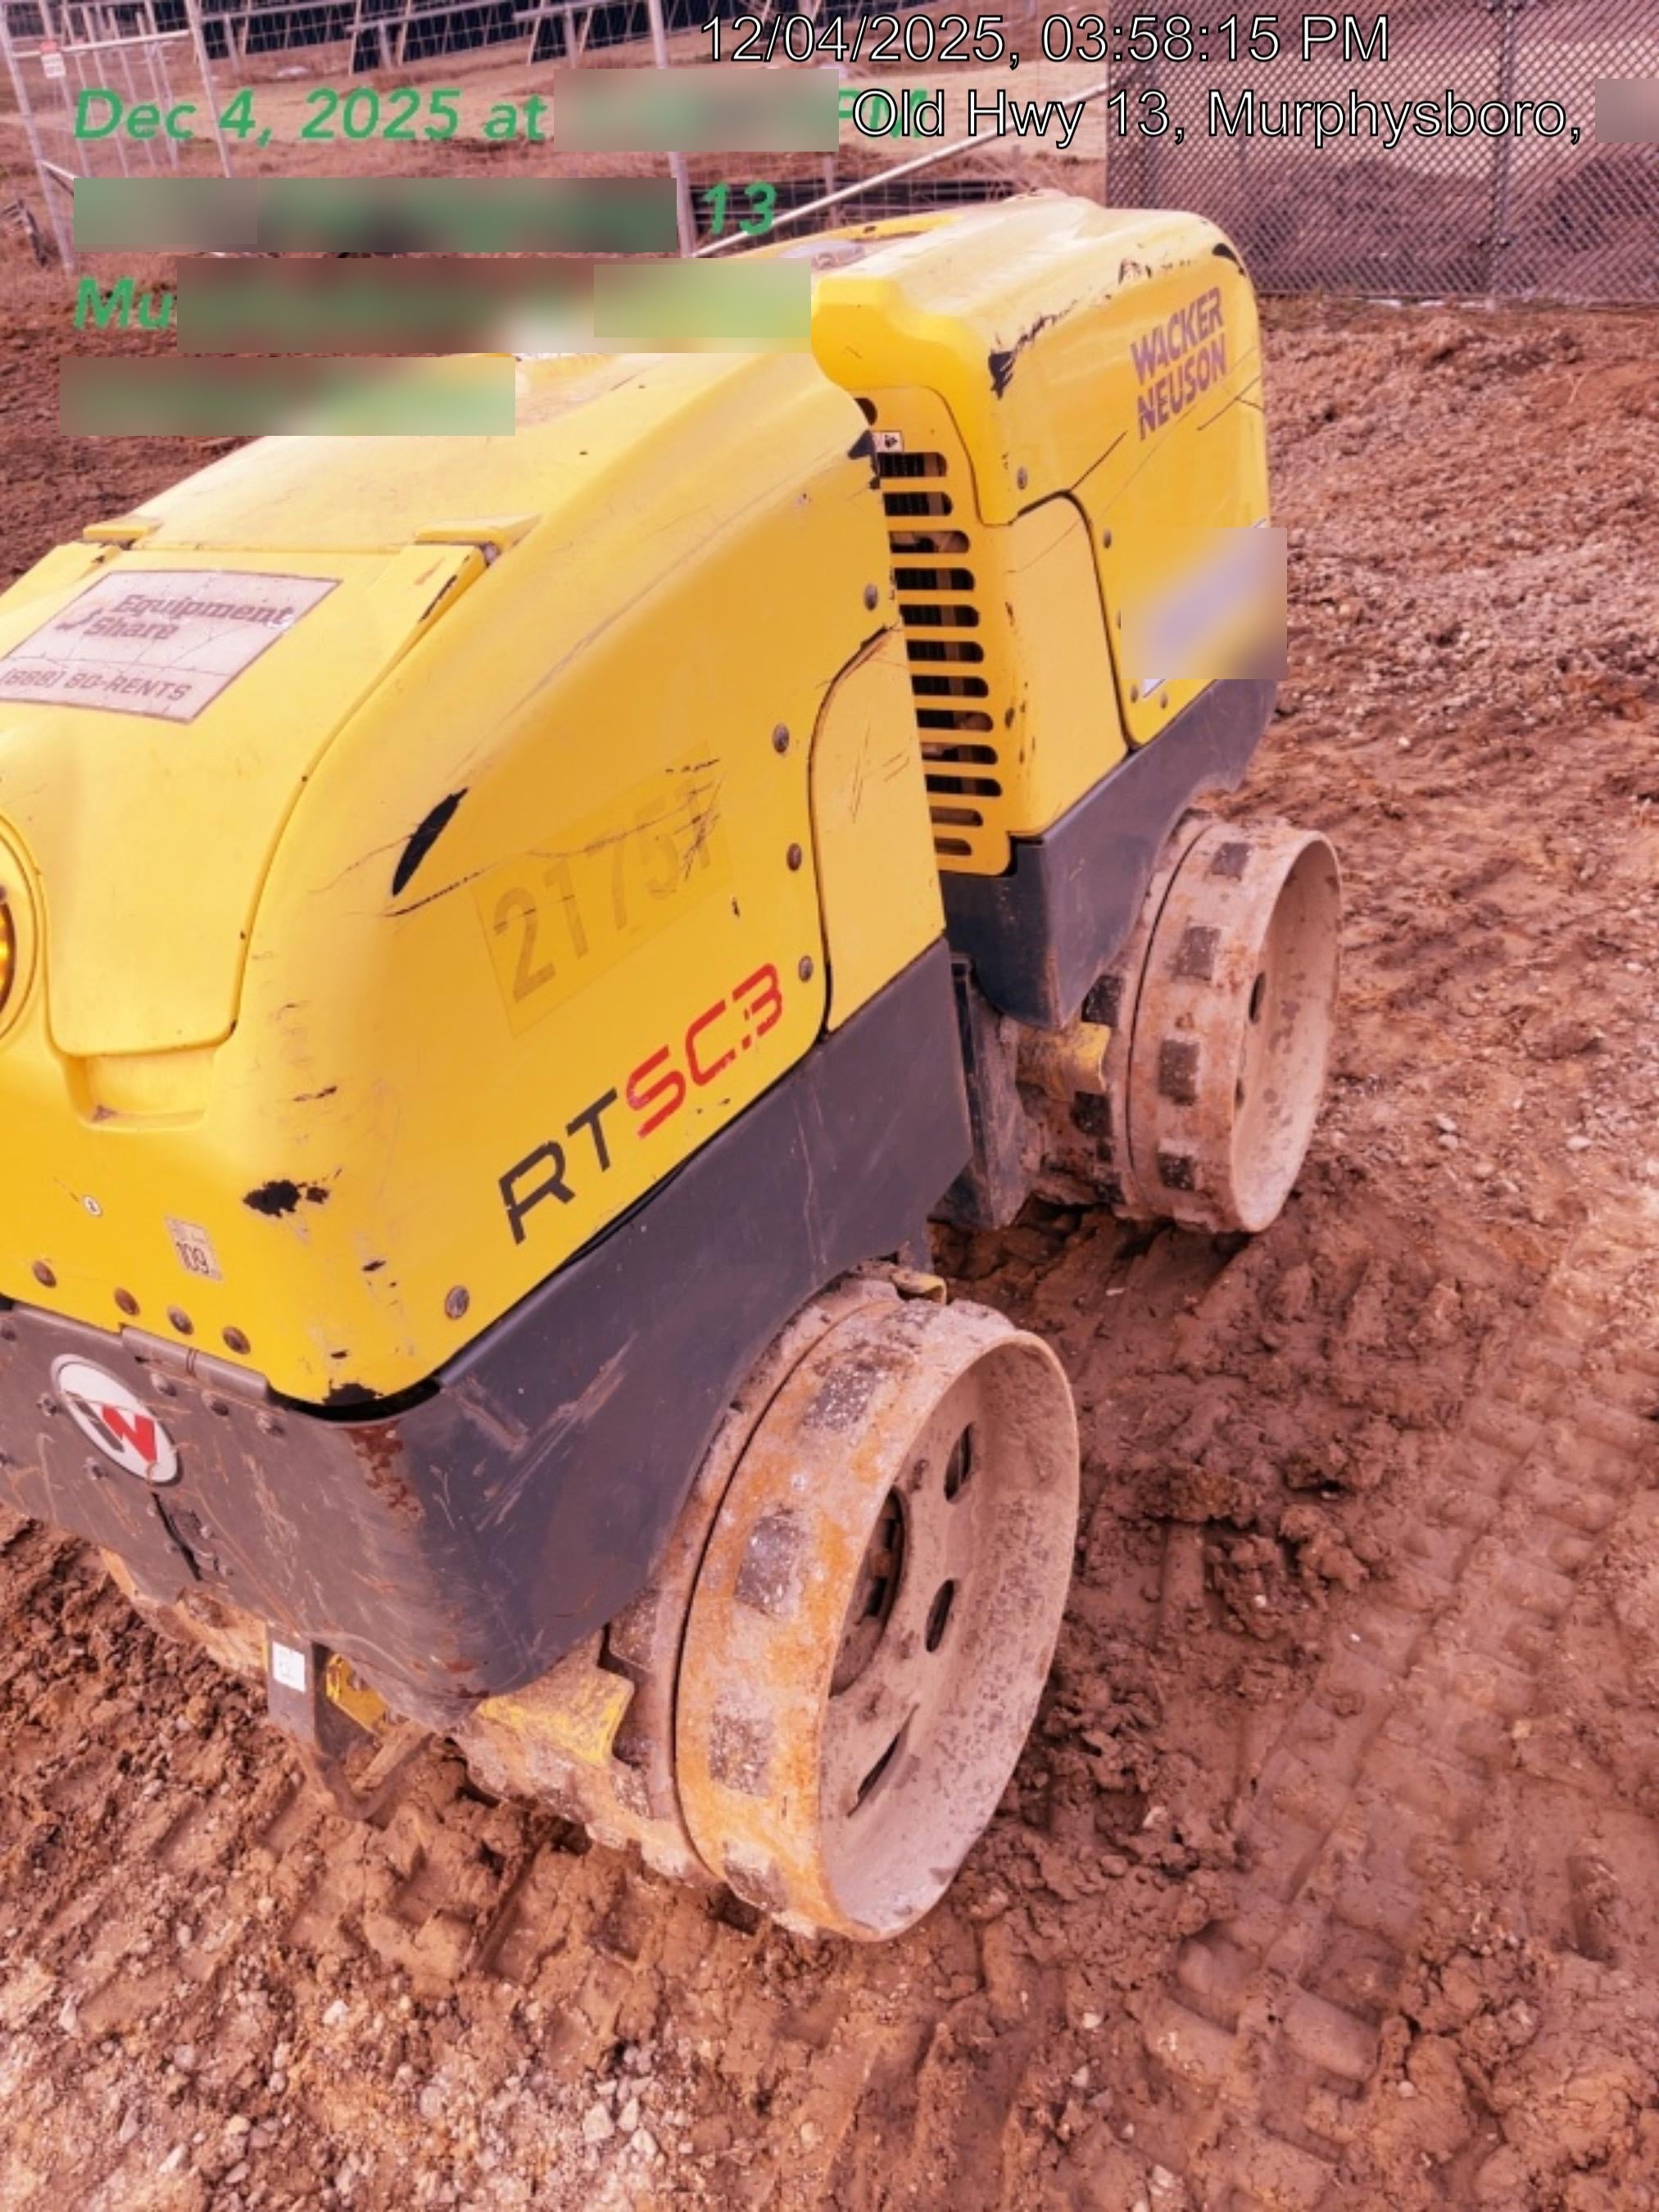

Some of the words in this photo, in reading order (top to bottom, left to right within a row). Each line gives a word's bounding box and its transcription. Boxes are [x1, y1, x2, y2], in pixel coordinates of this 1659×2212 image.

[1131, 286, 1224, 387] WACKER
[1136, 333, 1227, 442] NEUSON
[83, 615, 180, 641] Share
[111, 593, 295, 626] Equipment
